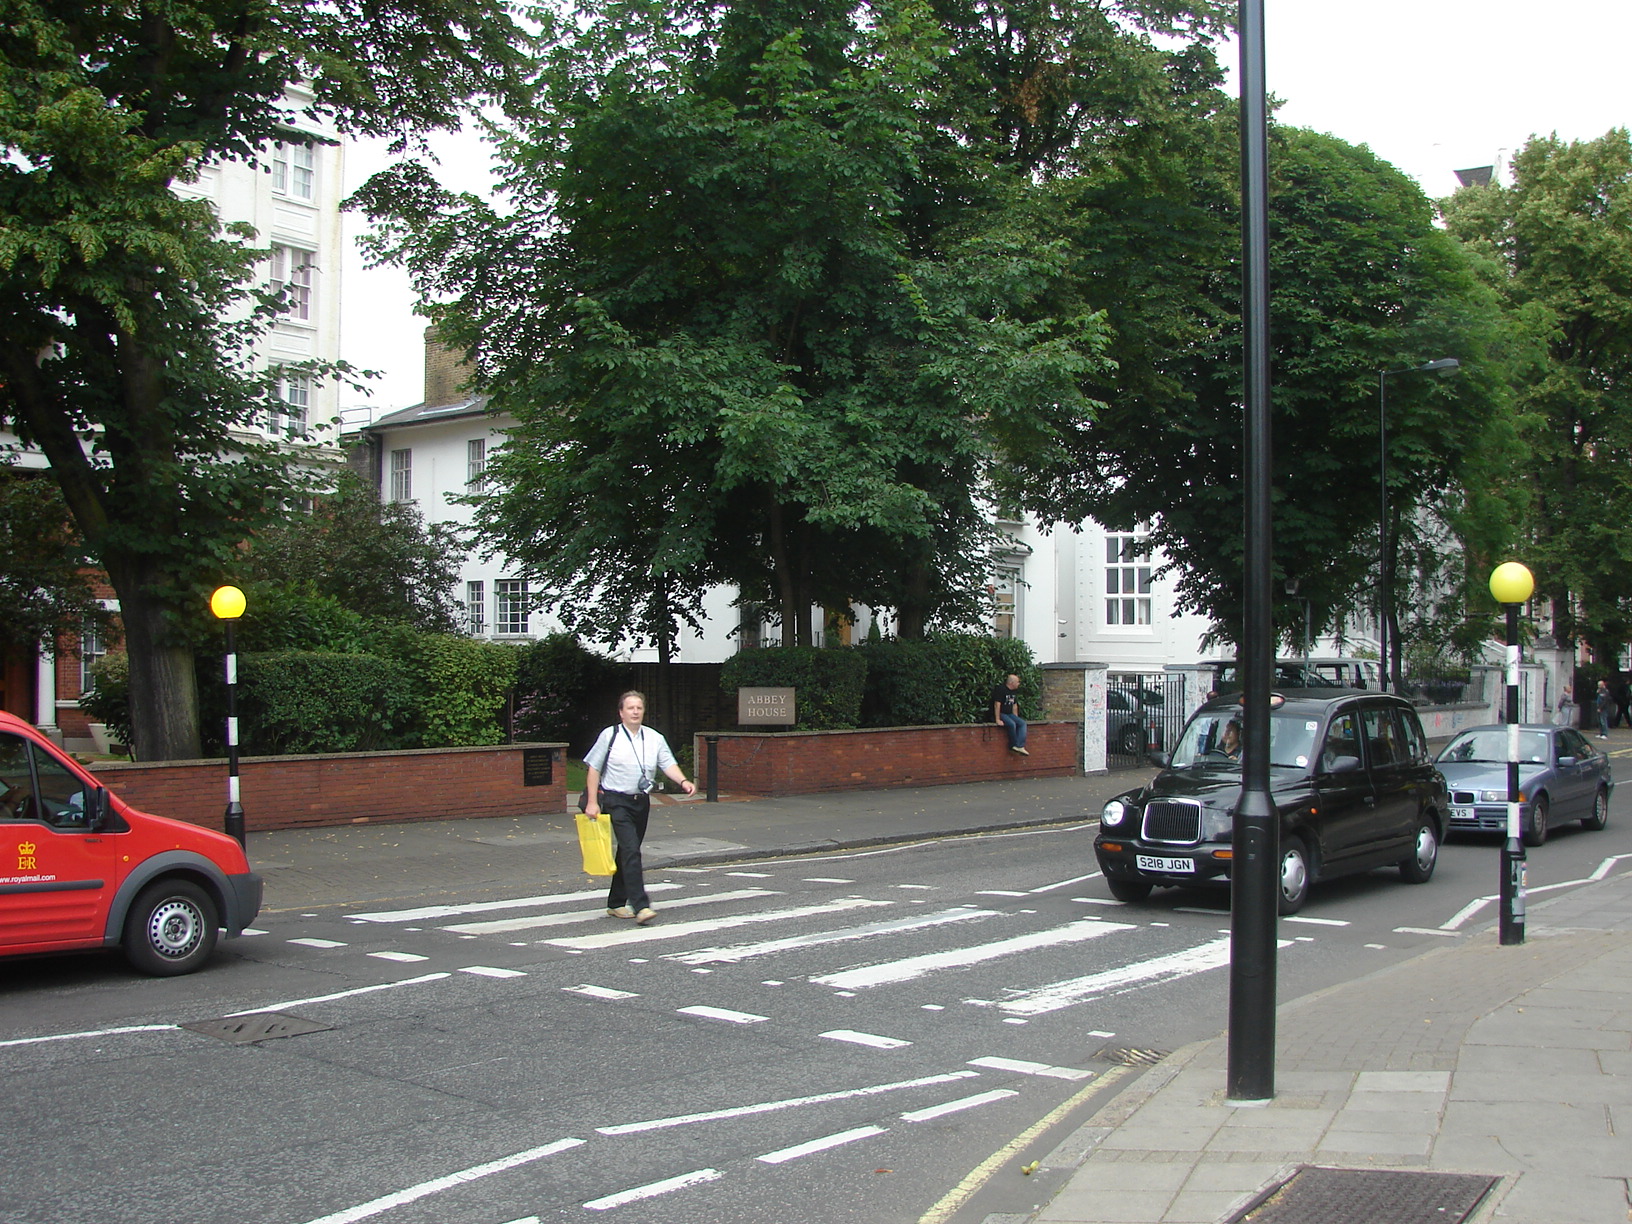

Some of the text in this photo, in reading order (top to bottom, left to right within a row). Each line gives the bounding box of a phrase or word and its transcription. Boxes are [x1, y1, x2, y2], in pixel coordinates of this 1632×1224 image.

[747, 695, 786, 704] ABBEY
[748, 708, 787, 717] HOUSE
[1139, 857, 1190, 870] S218 JGN
